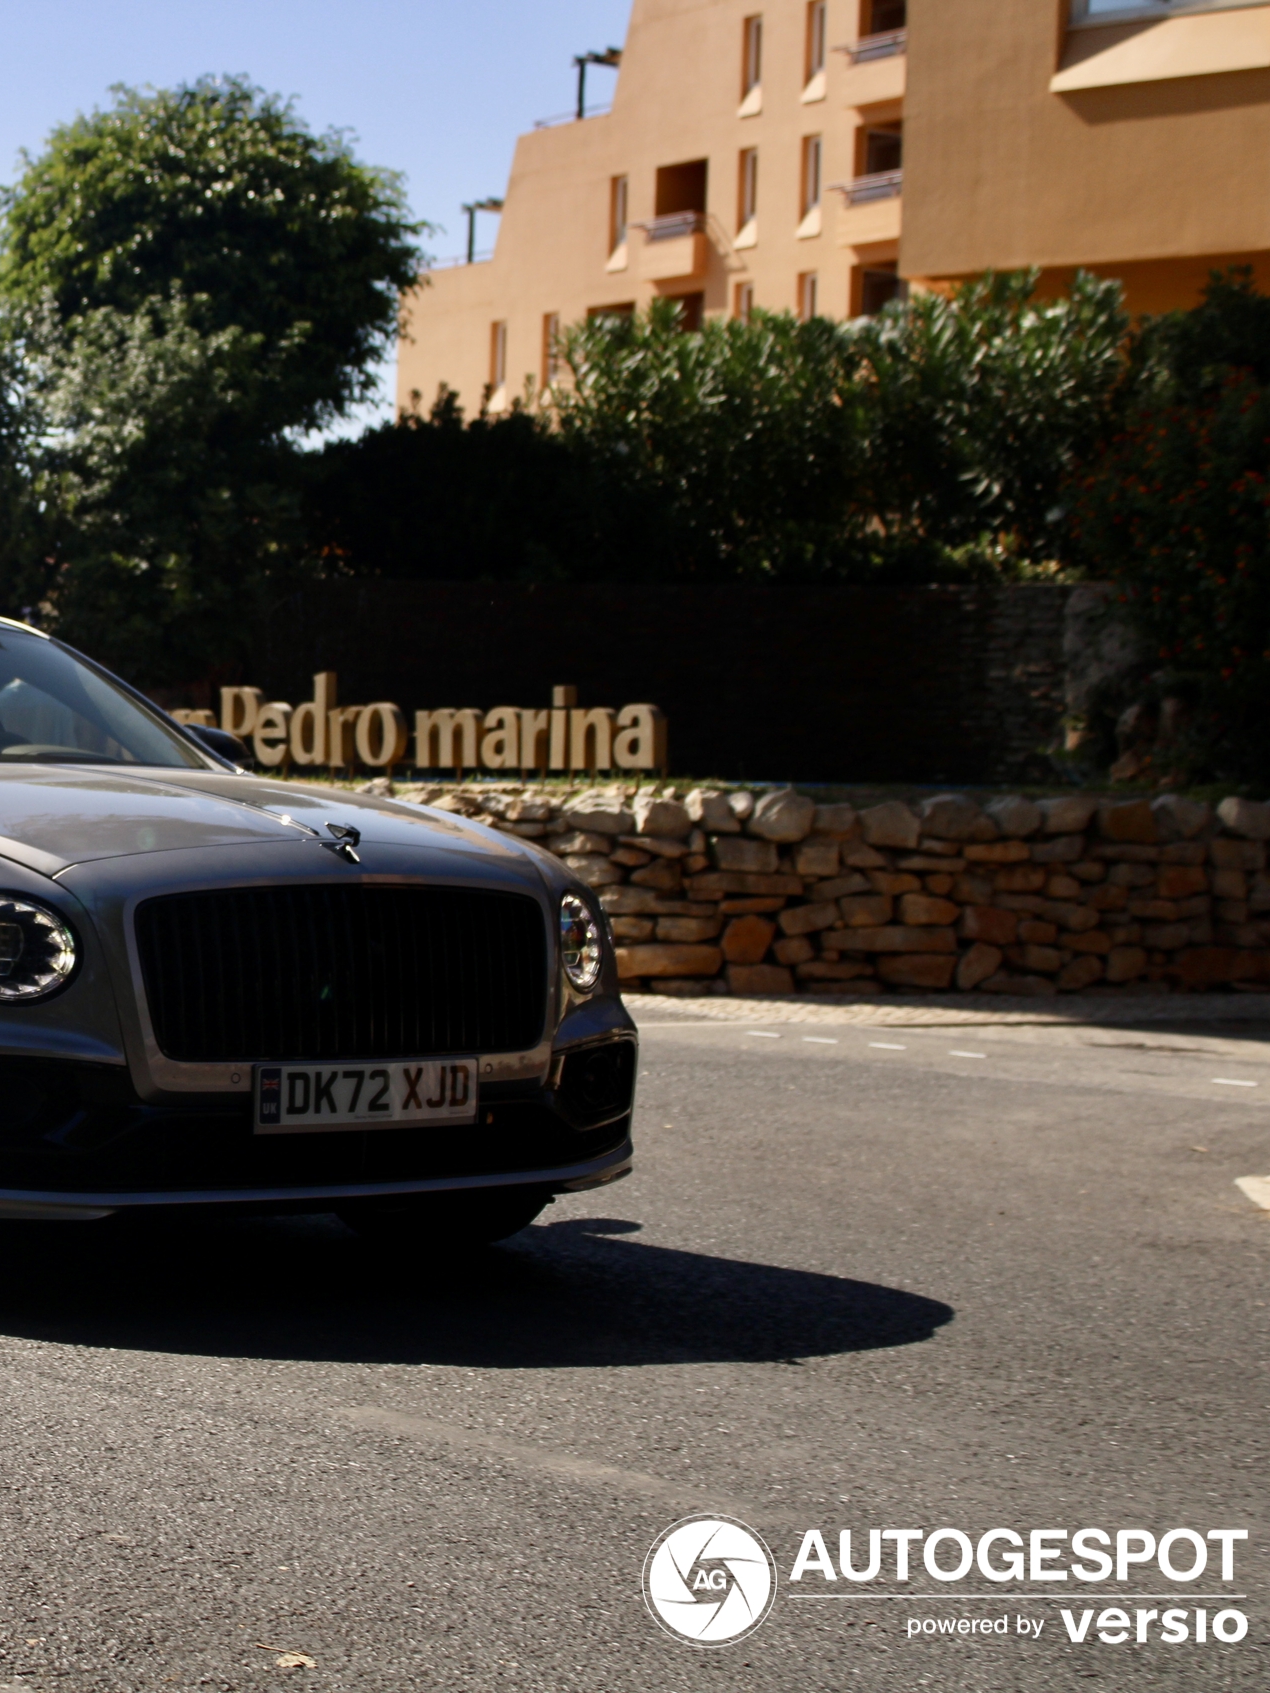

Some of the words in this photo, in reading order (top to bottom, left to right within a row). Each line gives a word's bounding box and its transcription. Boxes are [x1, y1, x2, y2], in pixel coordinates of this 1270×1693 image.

[220, 671, 407, 768] Pedro
[415, 685, 667, 770] marina
[262, 1102, 277, 1115] UK
[286, 1069, 390, 1115] DK72
[402, 1064, 469, 1110] XJD
